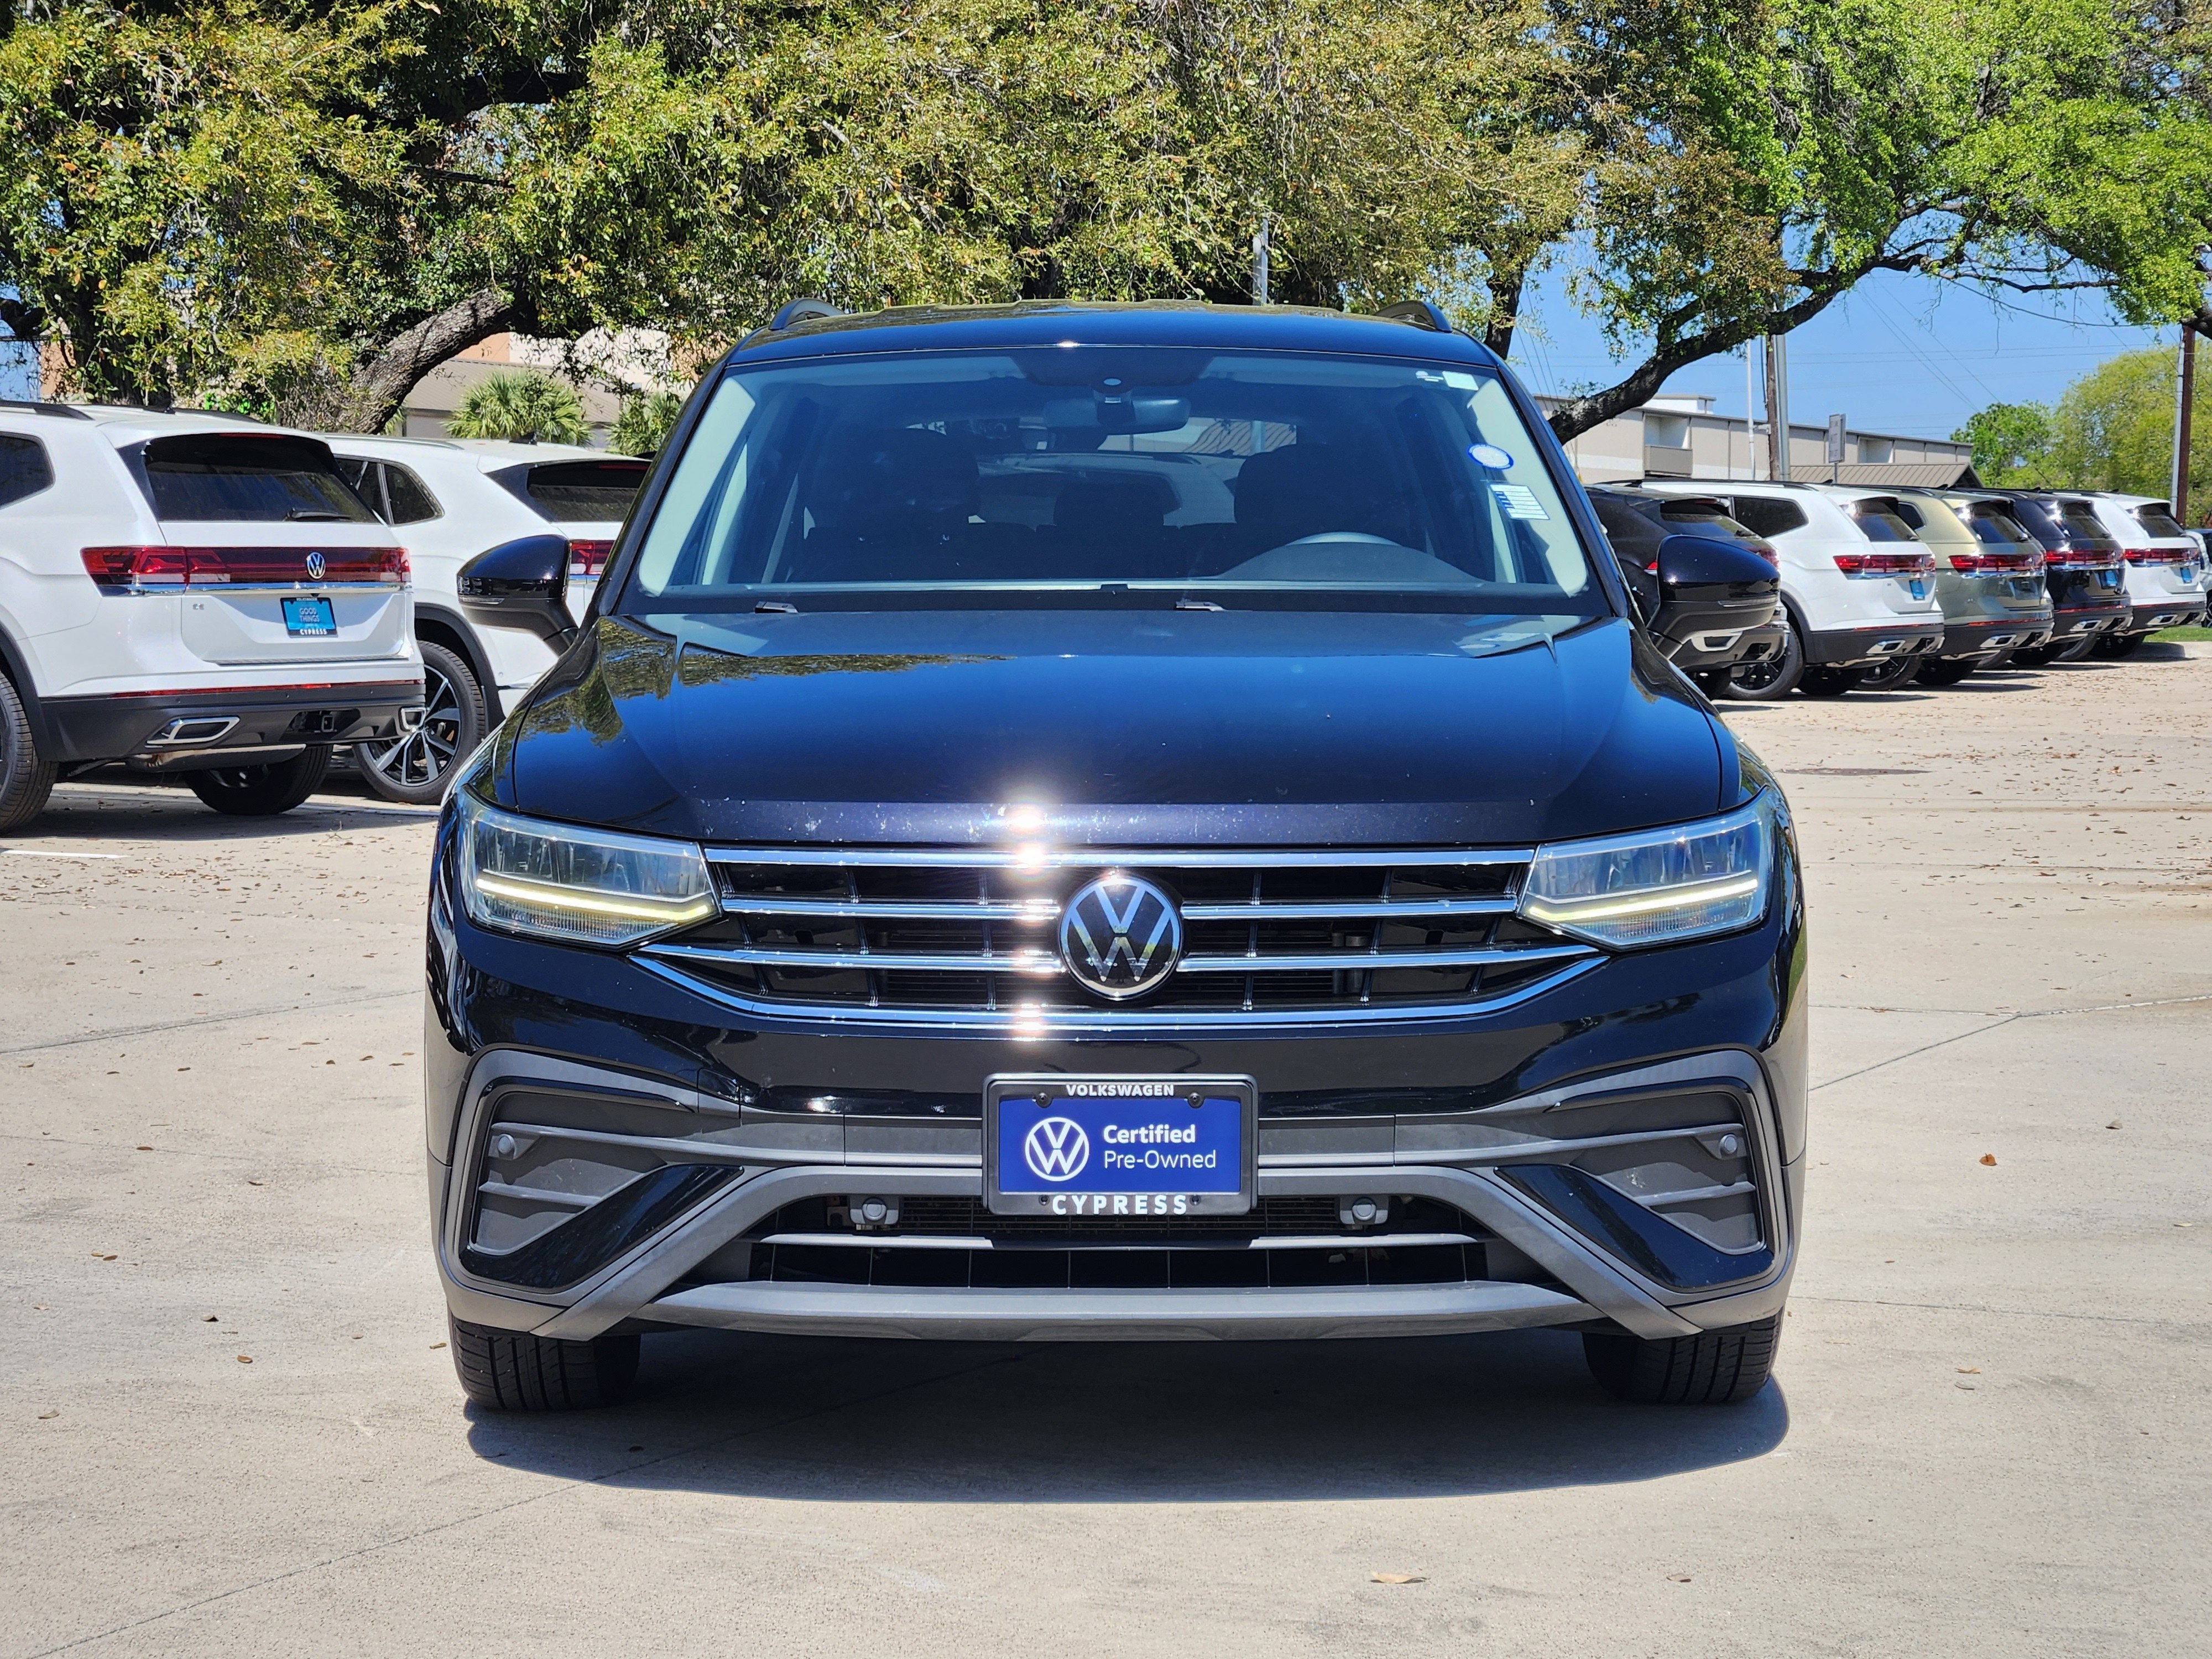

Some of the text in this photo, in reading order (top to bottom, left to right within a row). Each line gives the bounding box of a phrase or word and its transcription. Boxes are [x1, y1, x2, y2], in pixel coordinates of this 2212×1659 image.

[1058, 876, 1182, 1000] VW
[1066, 1084, 1174, 1097] VOLKSWAGEN
[1103, 1125, 1196, 1144] Certified
[1025, 1117, 1089, 1181] VW
[1104, 1150, 1216, 1168] Pre-Owned
[1052, 1194, 1187, 1215] CYPRESS
